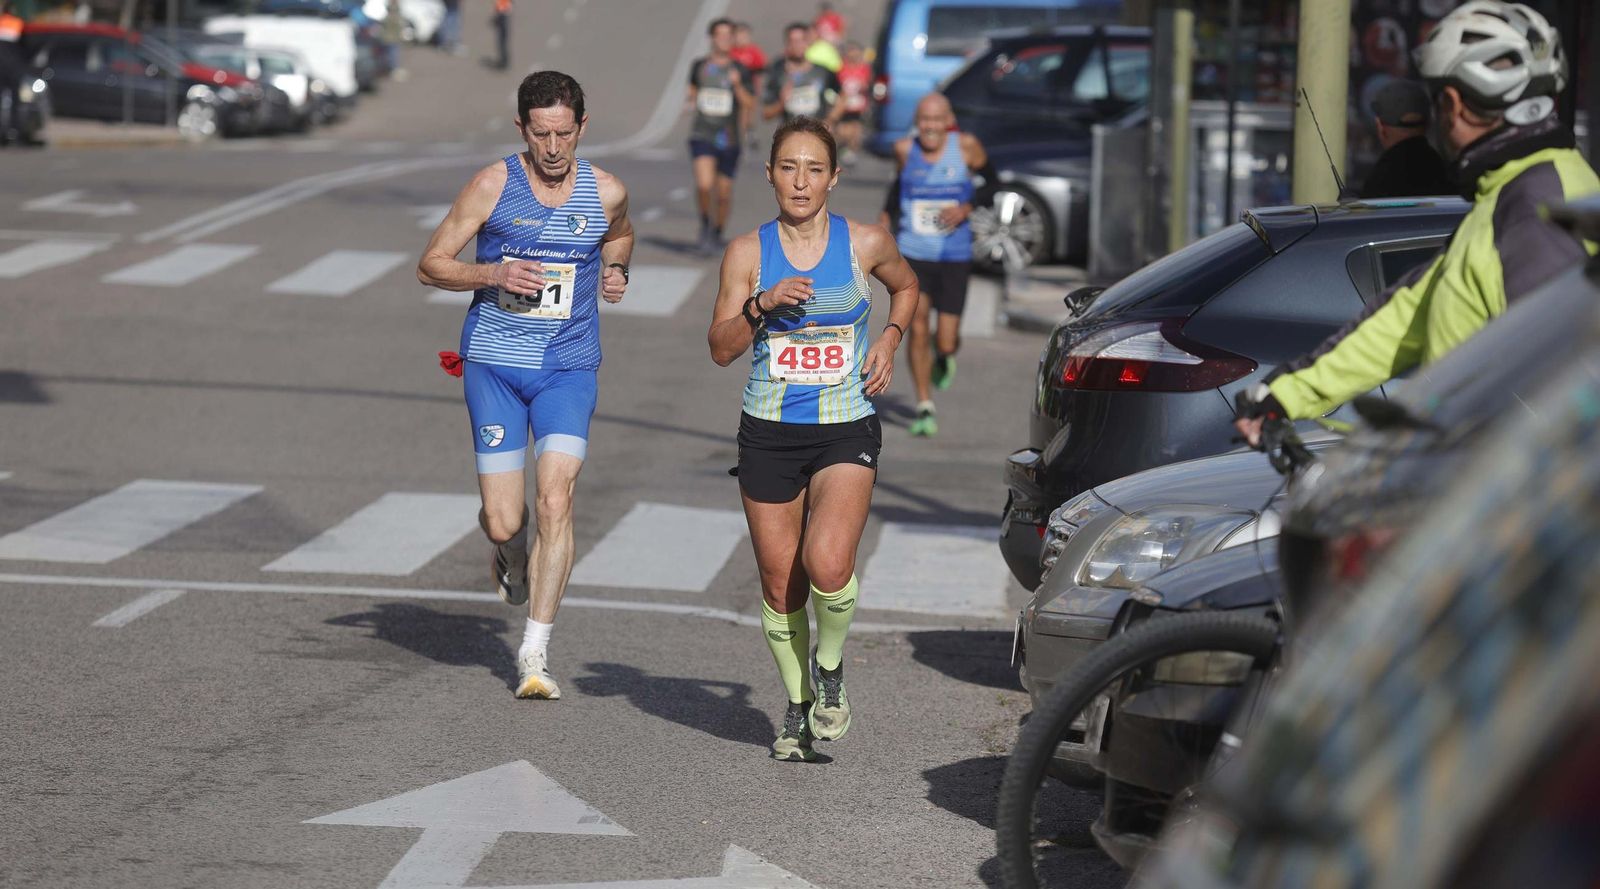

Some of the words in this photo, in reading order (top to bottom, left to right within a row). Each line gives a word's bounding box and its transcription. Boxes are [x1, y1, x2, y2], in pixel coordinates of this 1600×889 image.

[501, 243, 520, 255] Club
[520, 246, 566, 259] Atletismo
[778, 345, 844, 369] 488
